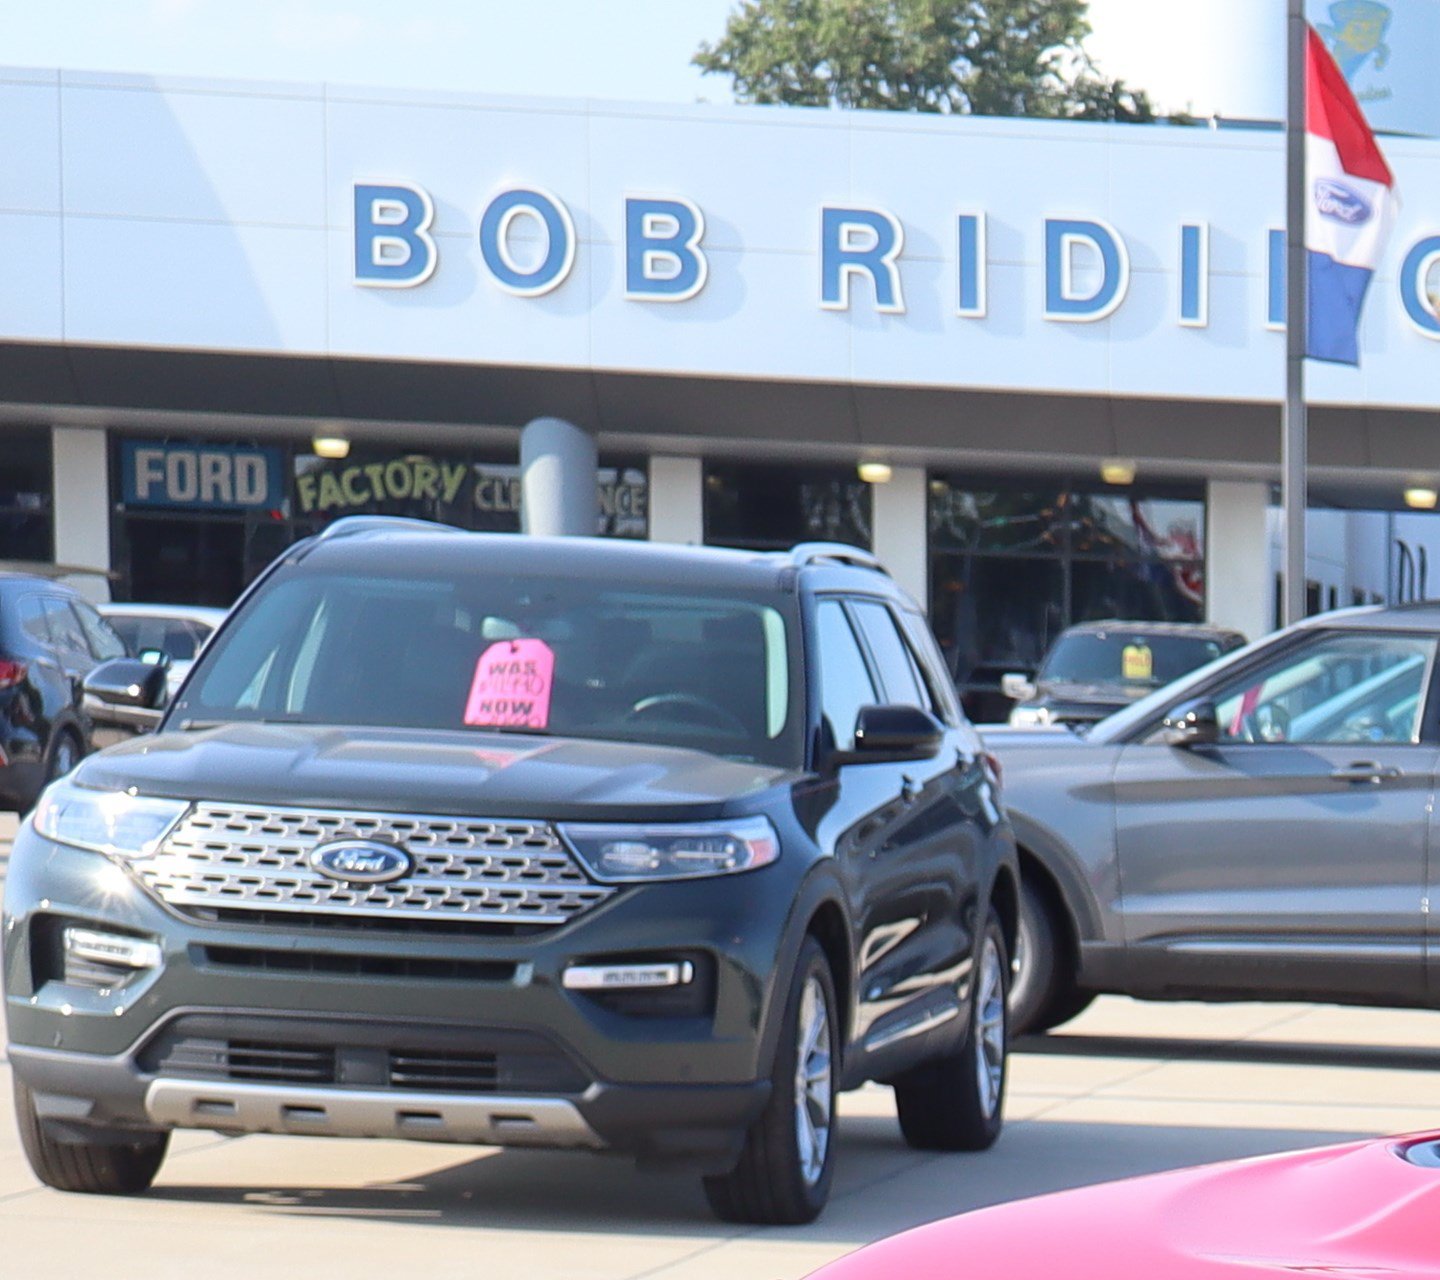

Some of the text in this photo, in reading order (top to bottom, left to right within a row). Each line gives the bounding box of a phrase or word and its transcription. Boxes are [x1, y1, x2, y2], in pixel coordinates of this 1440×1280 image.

[353, 179, 709, 299] BOB
[134, 448, 270, 503] FORD
[298, 459, 647, 517] FACTORY CLENCE
[488, 661, 537, 676] WAS
[480, 700, 533, 715] NOW
[332, 848, 387, 872] Ford
